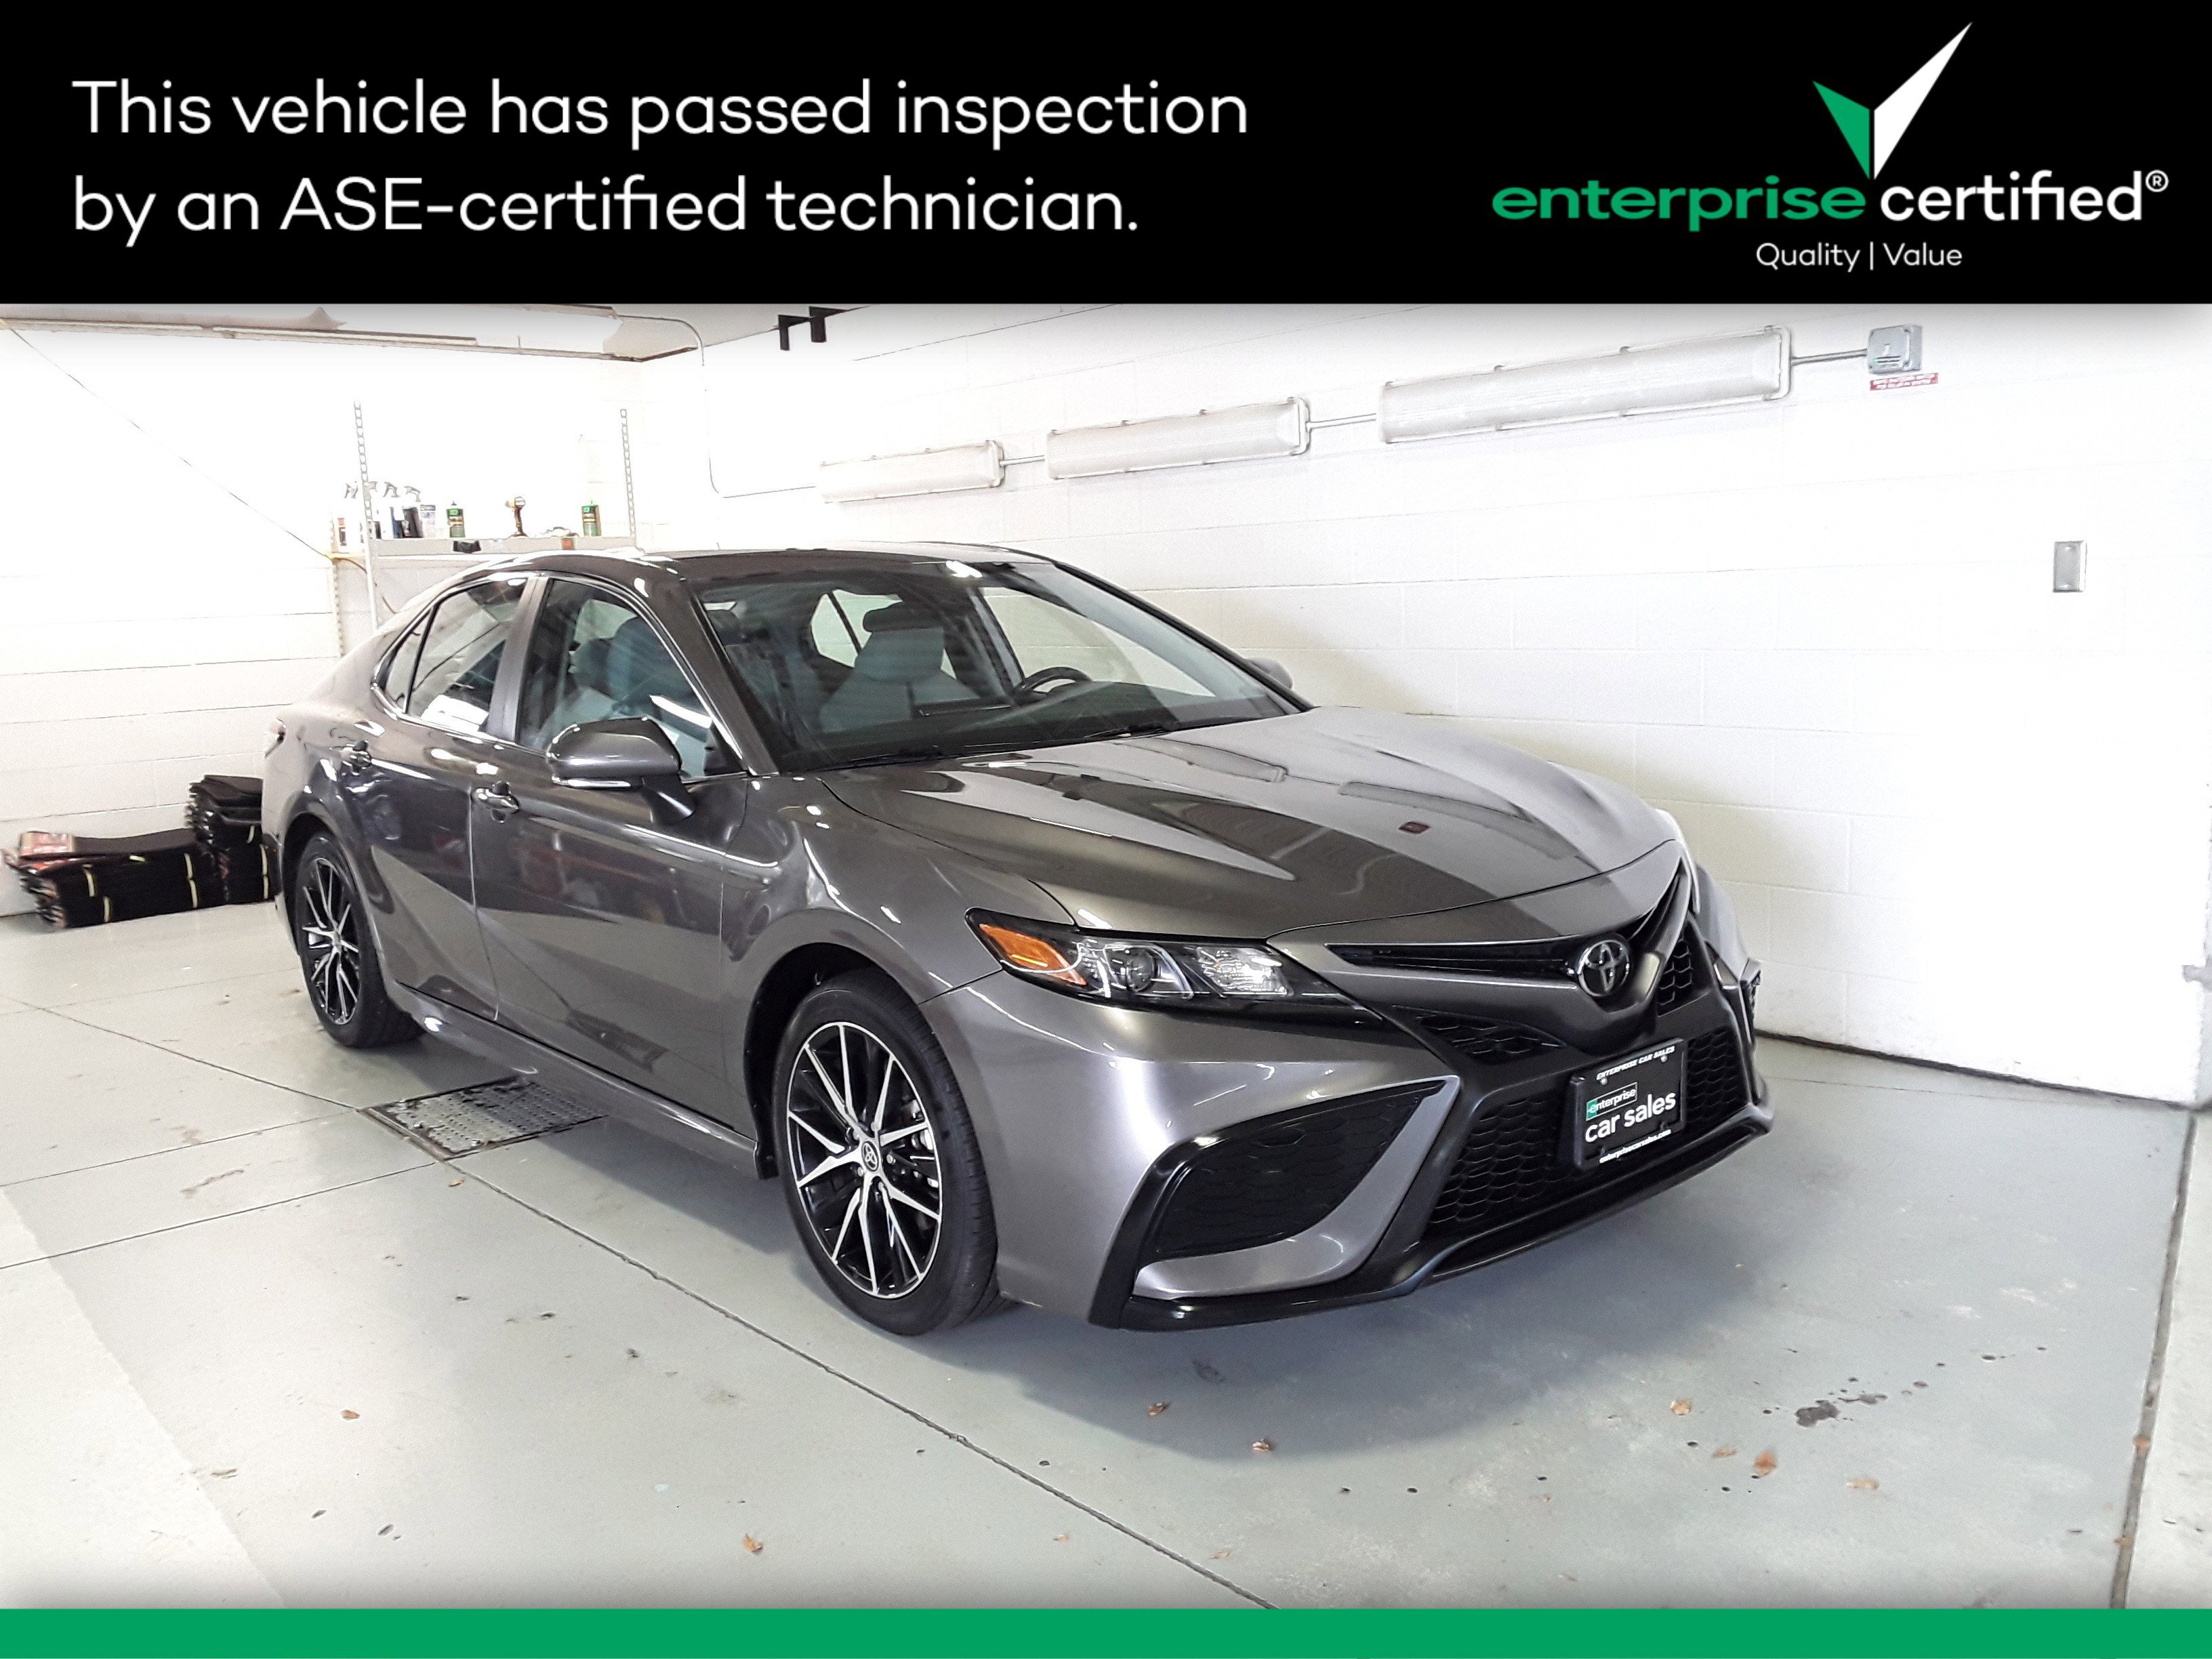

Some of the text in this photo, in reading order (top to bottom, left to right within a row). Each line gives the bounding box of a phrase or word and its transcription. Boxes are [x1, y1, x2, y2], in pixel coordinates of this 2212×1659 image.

[1585, 1092, 1676, 1143] car sales
[1588, 1089, 1637, 1113] enterprise
